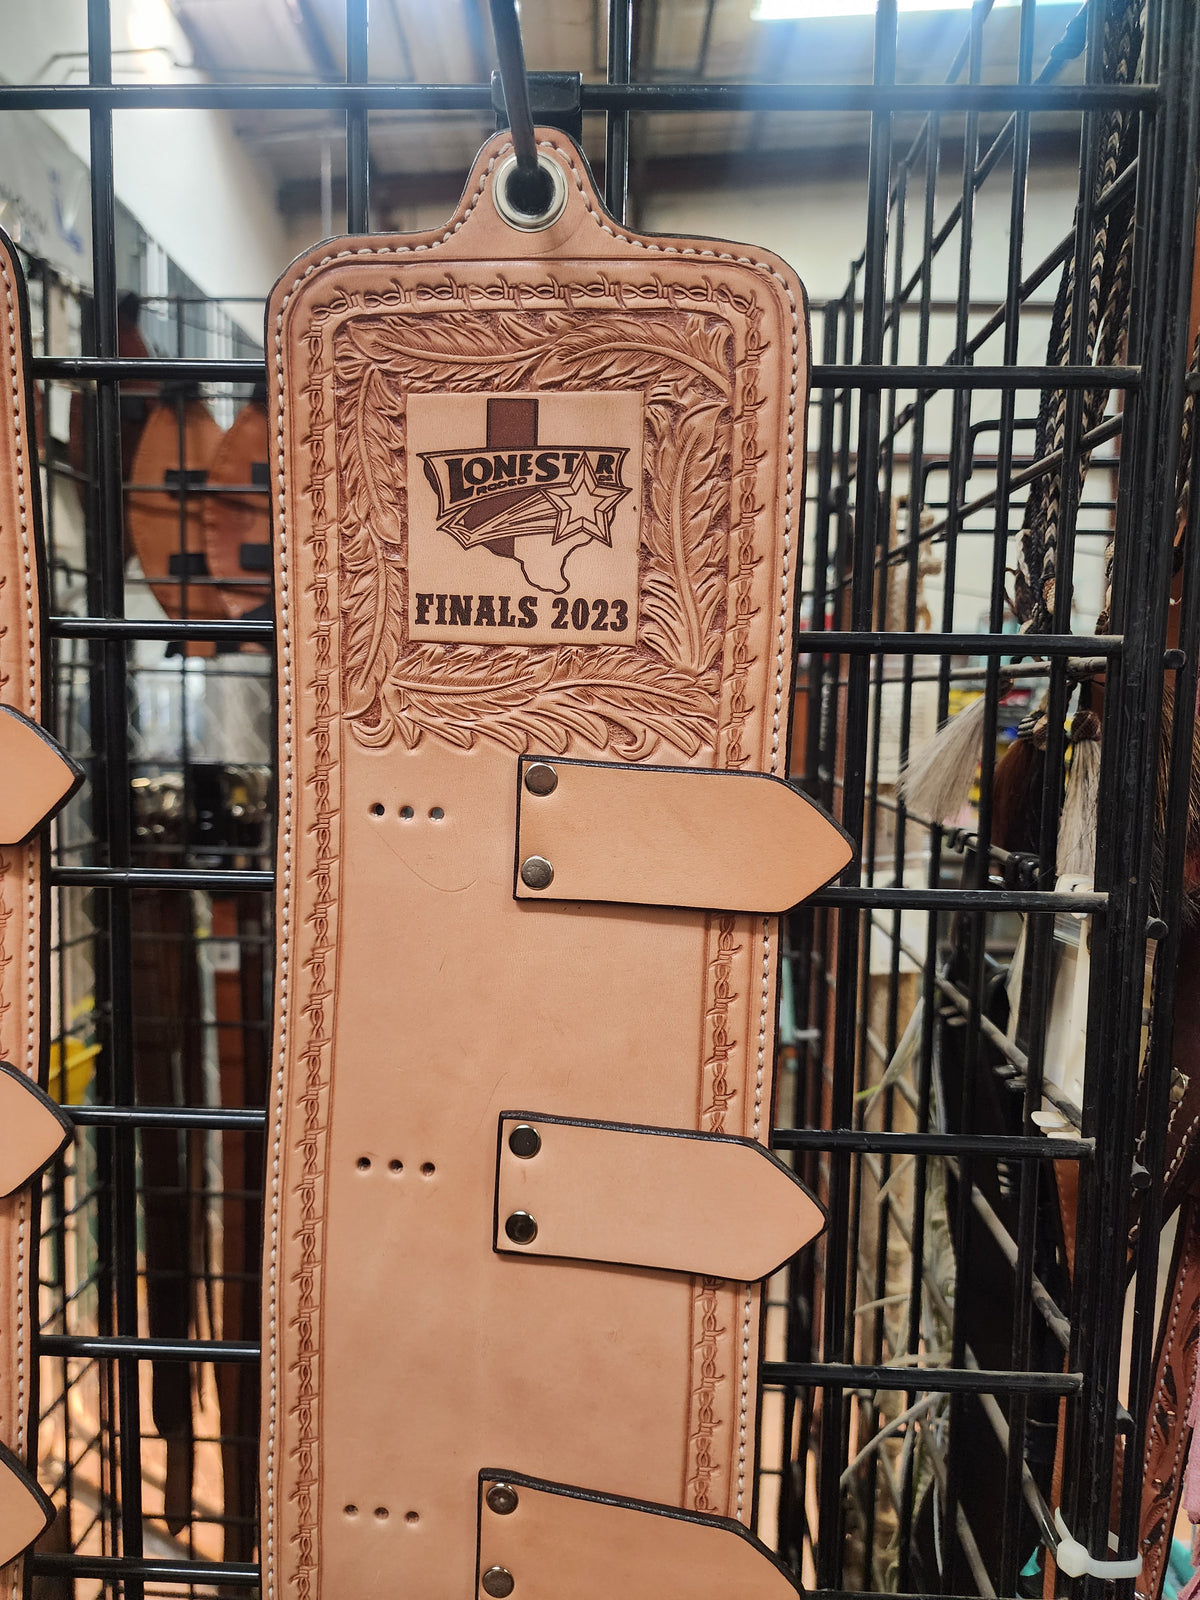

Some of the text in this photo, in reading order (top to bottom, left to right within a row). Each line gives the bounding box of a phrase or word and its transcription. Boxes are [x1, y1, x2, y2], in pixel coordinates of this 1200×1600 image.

[476, 477, 528, 496] RODEO
[415, 593, 629, 632] FINALS 2023
